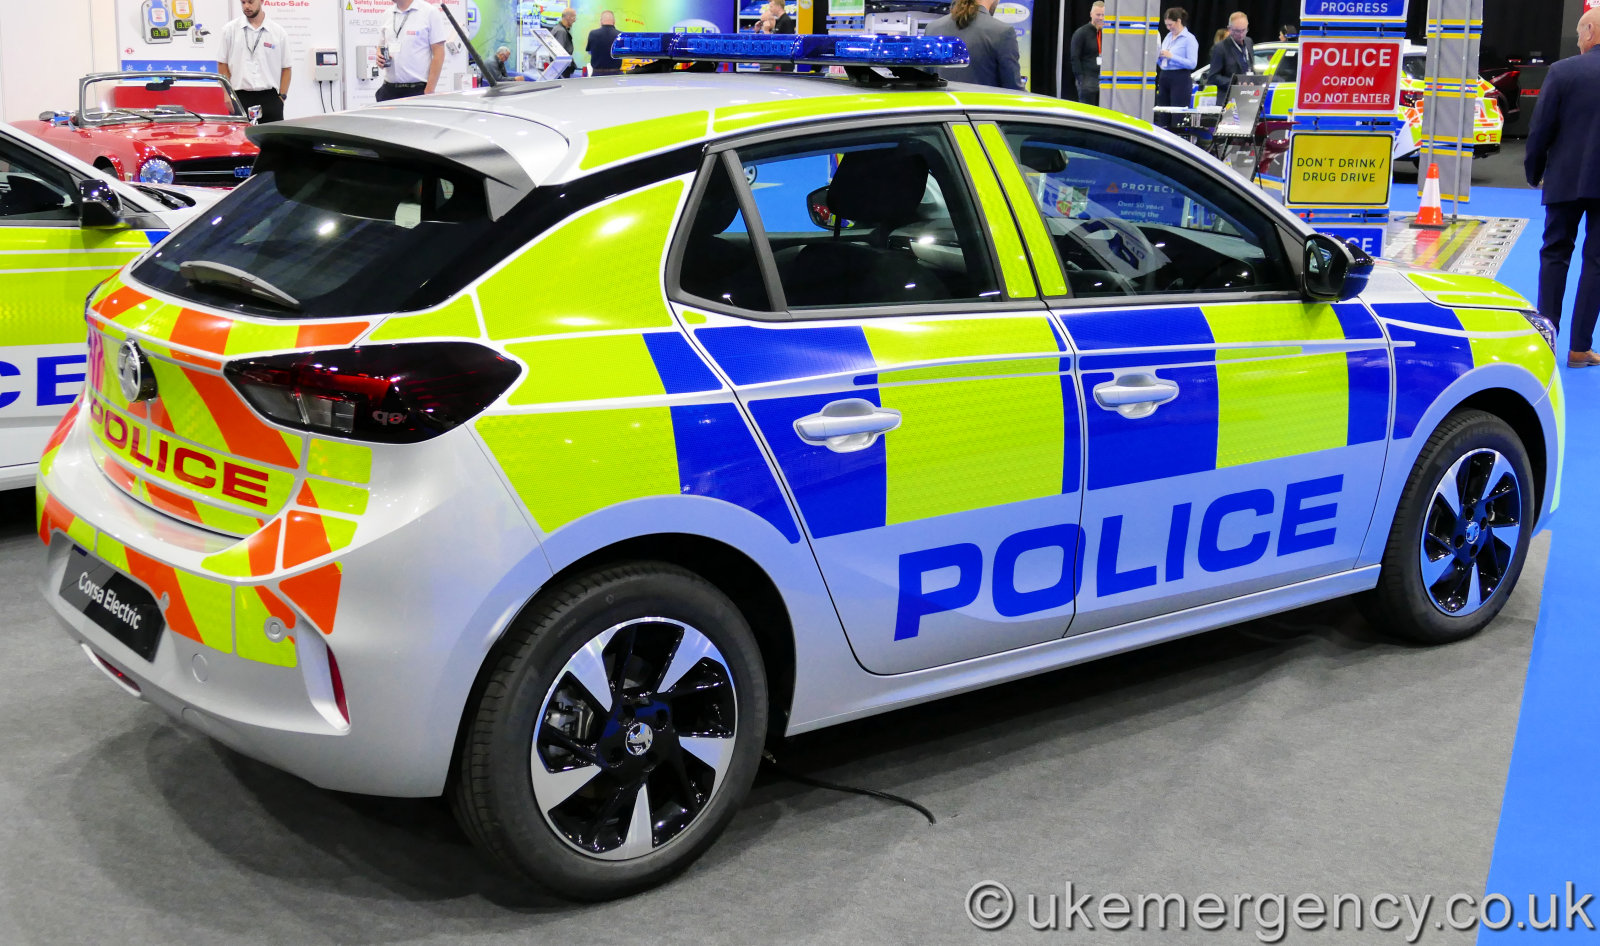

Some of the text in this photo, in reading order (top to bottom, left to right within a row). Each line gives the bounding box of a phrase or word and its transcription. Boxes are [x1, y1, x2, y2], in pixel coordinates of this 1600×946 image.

[1320, 2, 1389, 13] PROGRESS
[1309, 47, 1392, 67] POLICE
[1322, 76, 1375, 87] CORDON
[1304, 92, 1391, 104] DO NOT ENTER
[1297, 157, 1335, 167] DON'T
[1338, 158, 1376, 168] DRINK
[1302, 172, 1376, 182] DRUG DRIVE
[1117, 200, 1134, 208] Over
[1147, 211, 1160, 219] the
[90, 396, 269, 508] POLICE
[894, 473, 1344, 642] POLICE
[78, 571, 142, 630] Corsa Electric
